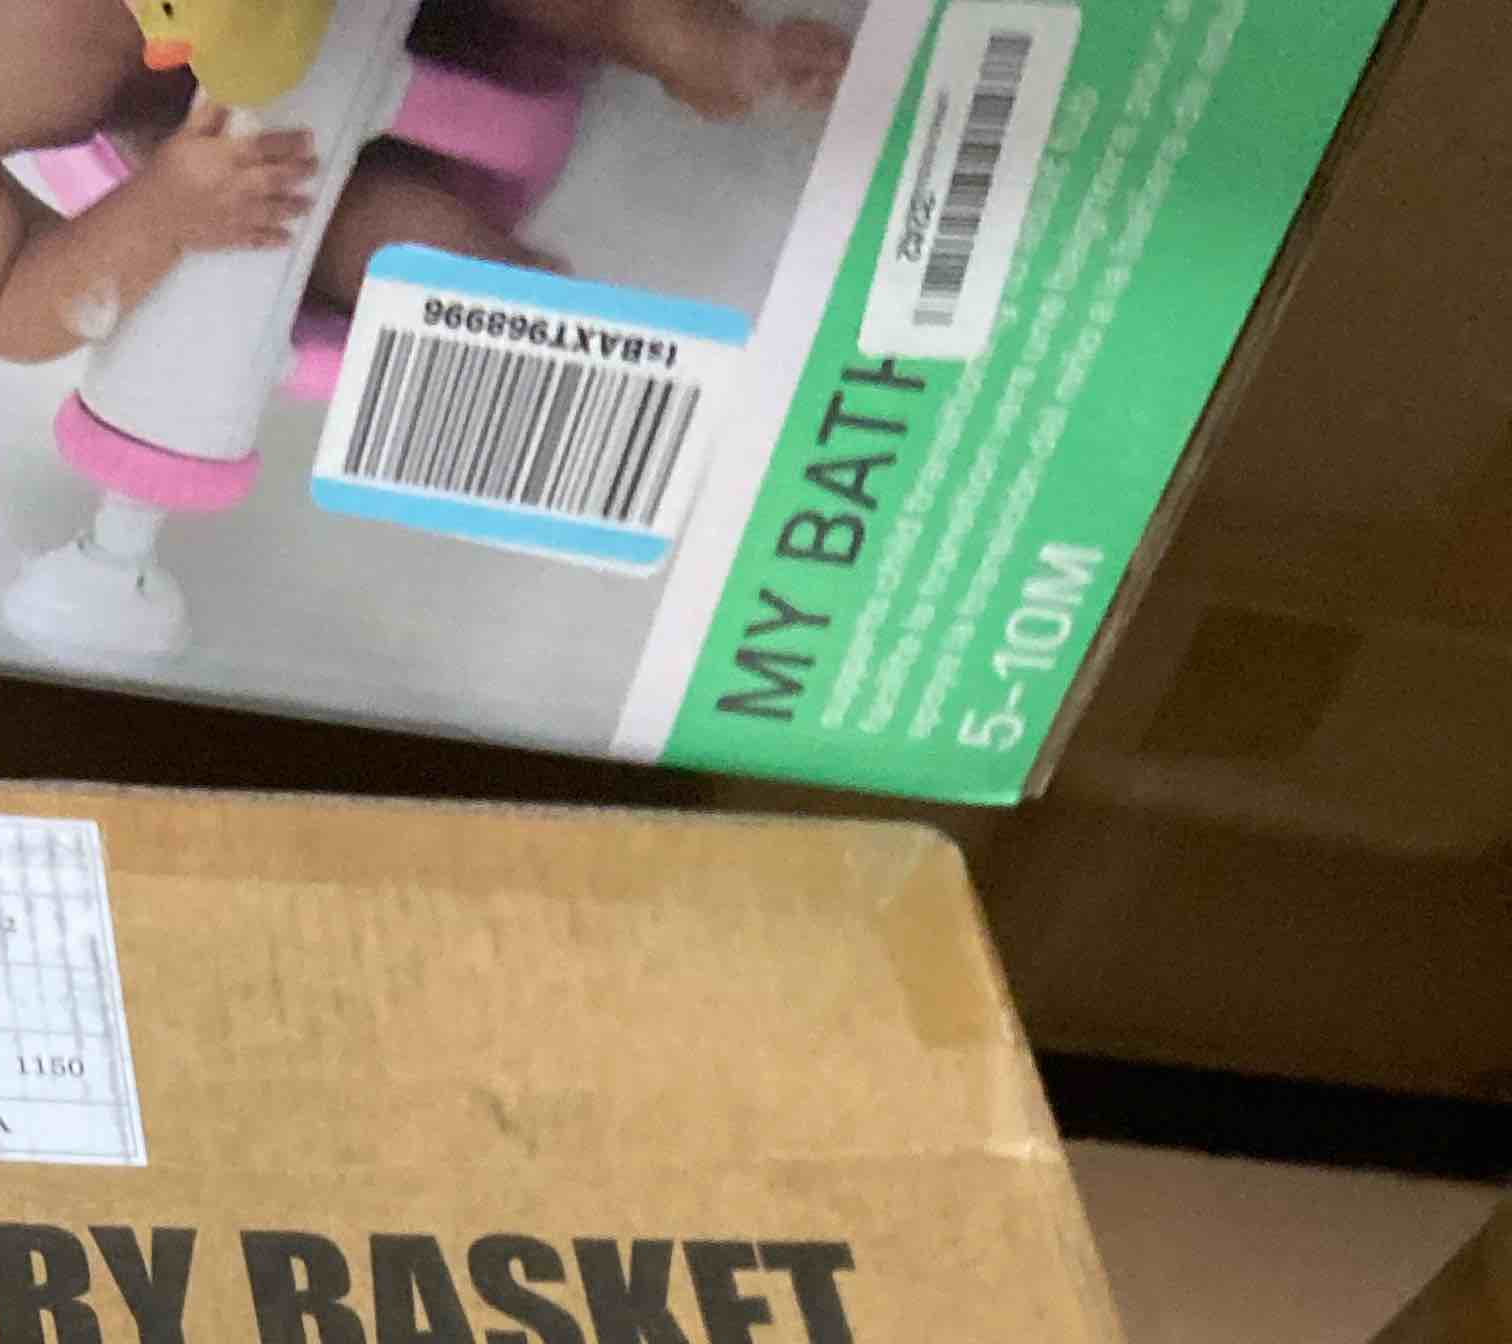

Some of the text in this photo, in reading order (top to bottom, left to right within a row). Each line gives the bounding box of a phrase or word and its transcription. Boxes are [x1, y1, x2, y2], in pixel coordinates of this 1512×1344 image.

[716, 586, 832, 725] MY
[957, 541, 1107, 752] 5-10M
[15, 1054, 86, 1079] 1150
